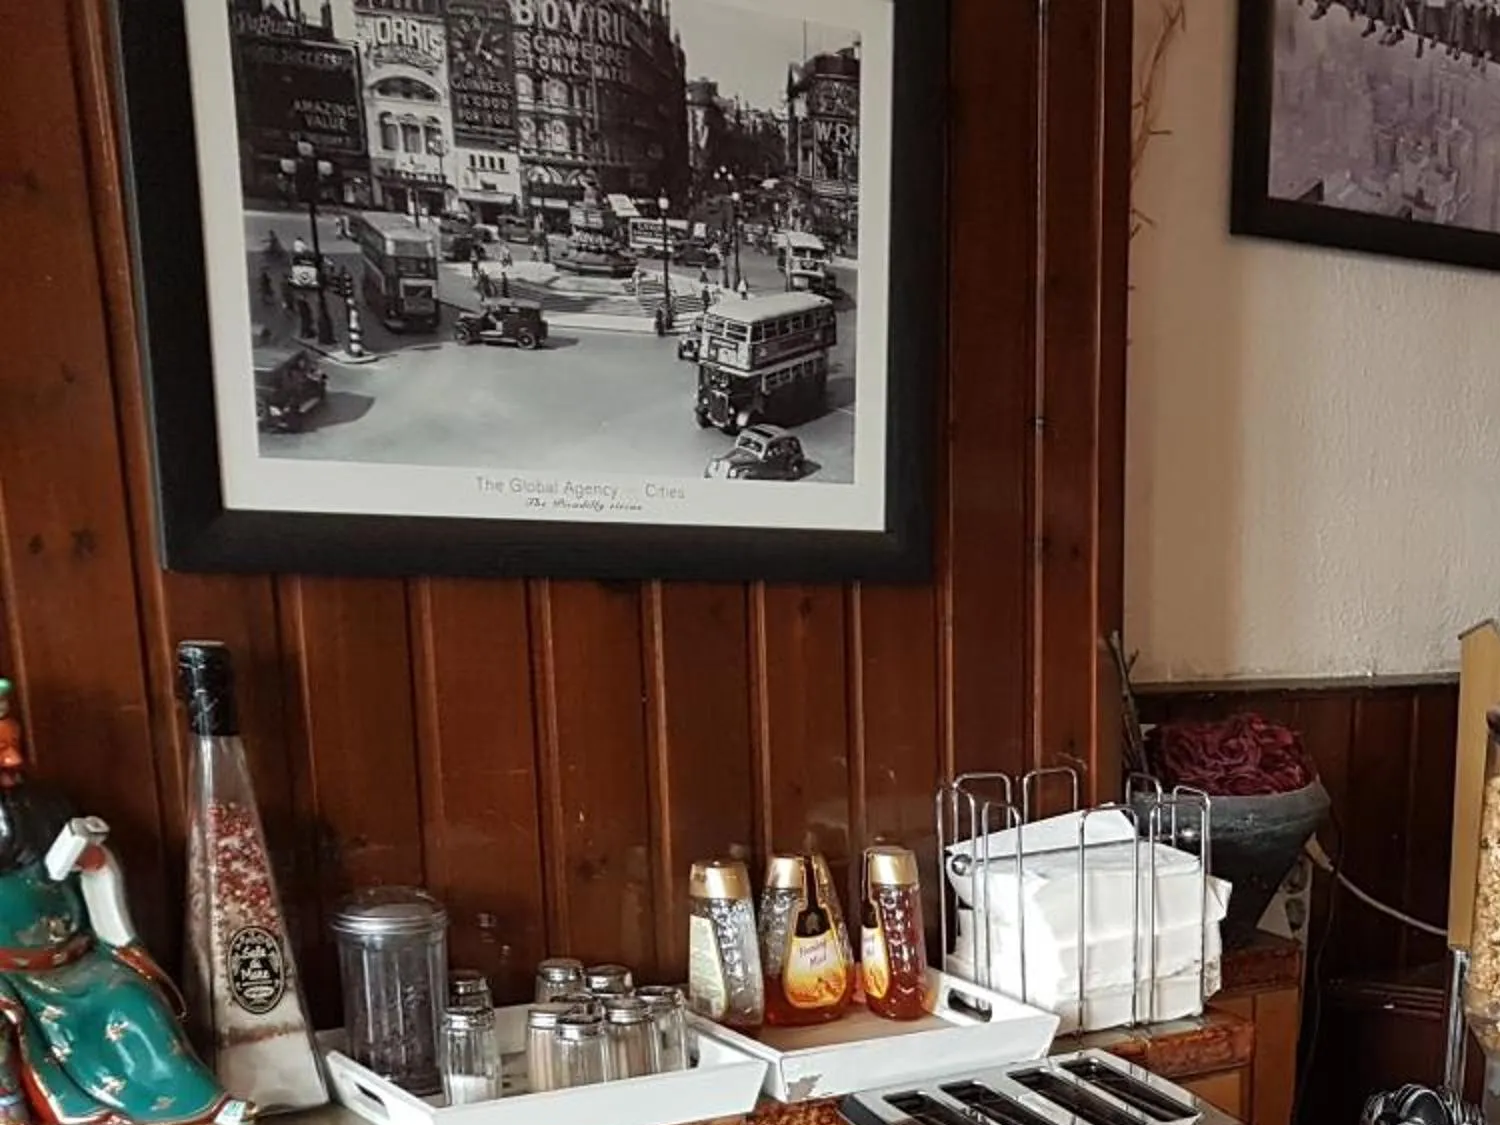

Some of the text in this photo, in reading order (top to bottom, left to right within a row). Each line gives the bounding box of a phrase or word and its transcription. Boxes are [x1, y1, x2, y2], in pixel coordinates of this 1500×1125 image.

[512, 0, 631, 48] BOVRIL
[526, 54, 581, 75] TONIC
[476, 476, 685, 499] The Global Agency Cities
